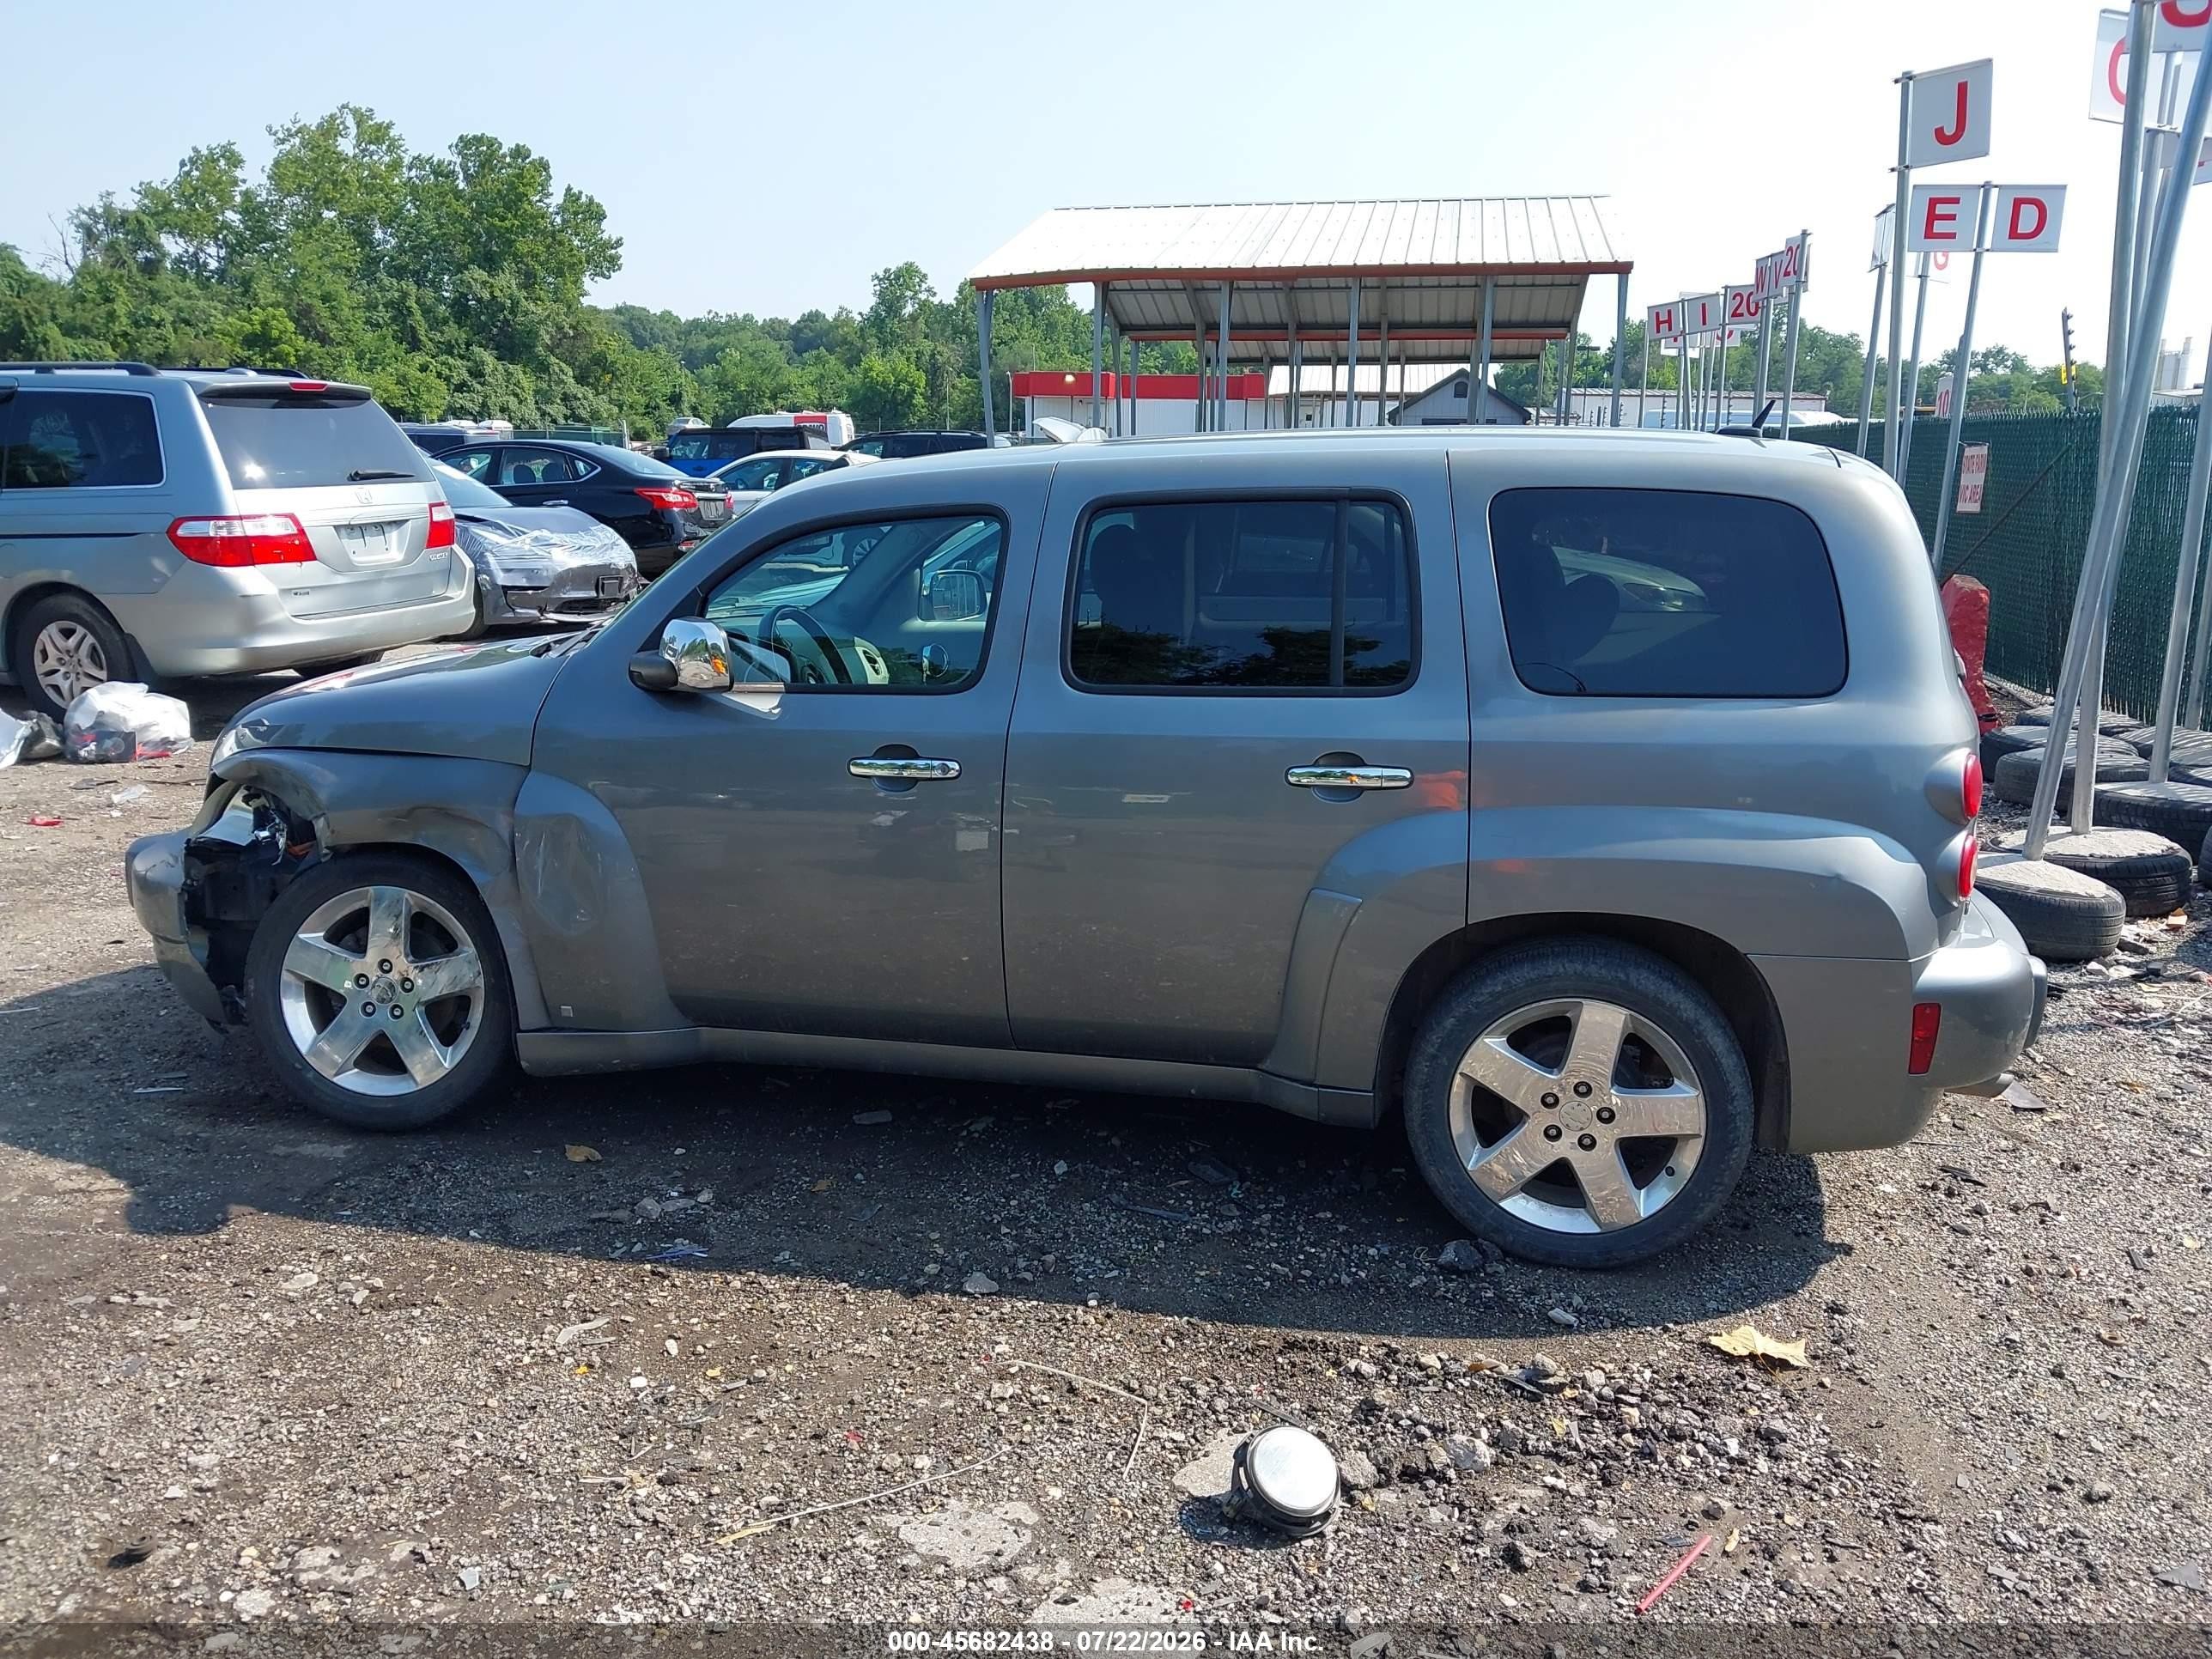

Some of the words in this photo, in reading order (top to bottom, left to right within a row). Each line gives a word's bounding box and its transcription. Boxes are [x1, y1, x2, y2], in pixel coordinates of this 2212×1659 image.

[1934, 80, 1968, 146] J
[1923, 197, 1960, 240] E
[2008, 197, 2048, 240] D
[1756, 265, 1767, 294] W
[1774, 260, 1784, 289] V
[1655, 308, 1673, 334] H
[1701, 302, 1707, 325] I
[1938, 389, 1949, 417] 10
